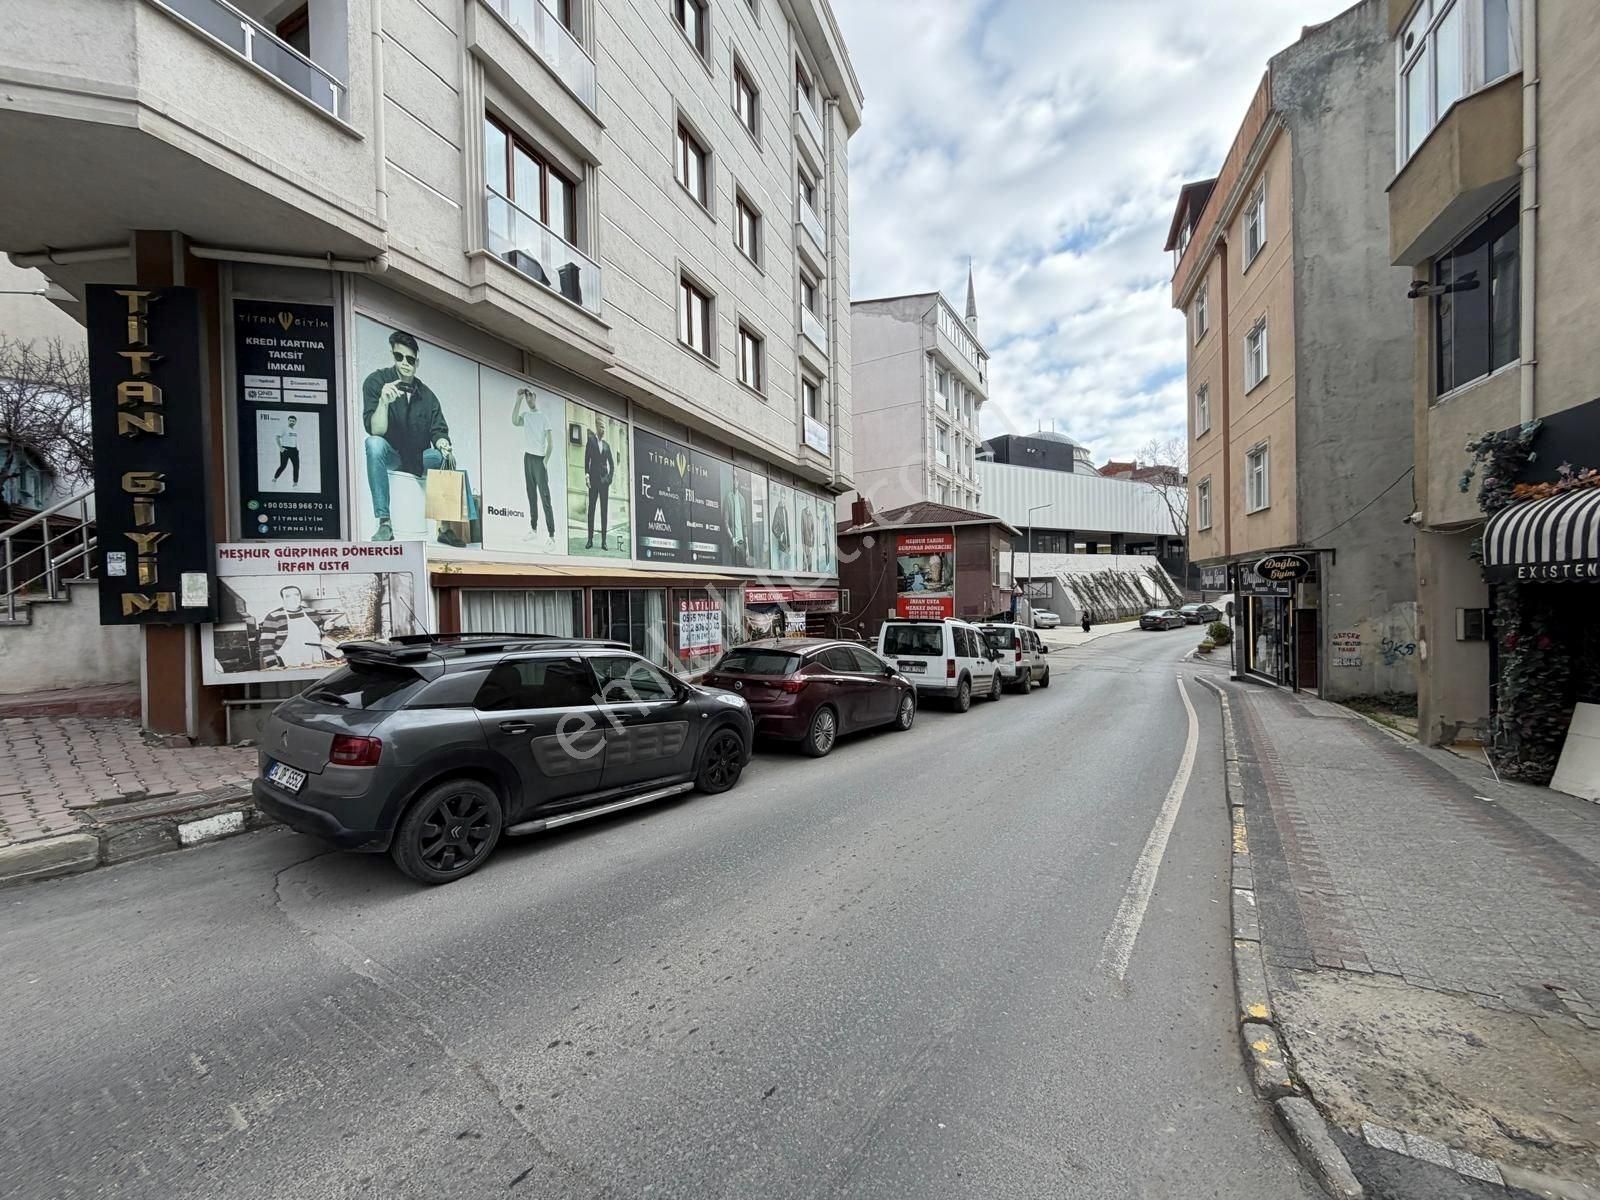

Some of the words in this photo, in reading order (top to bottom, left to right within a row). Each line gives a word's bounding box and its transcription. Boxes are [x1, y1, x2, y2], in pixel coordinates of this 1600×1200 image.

[245, 336, 277, 346] KREDİ
[280, 339, 325, 350] KARTINA
[268, 350, 303, 360] TAKSİT
[267, 361, 305, 372] İMKANI
[219, 549, 270, 562] MEŞHUR
[274, 546, 338, 558] GÜRPINAR
[342, 544, 403, 557] DÖNERCİSİ
[277, 561, 315, 572] İRFAN
[318, 561, 350, 571] USTA
[1265, 558, 1300, 570] Dağlar
[681, 601, 721, 610] SATILIK
